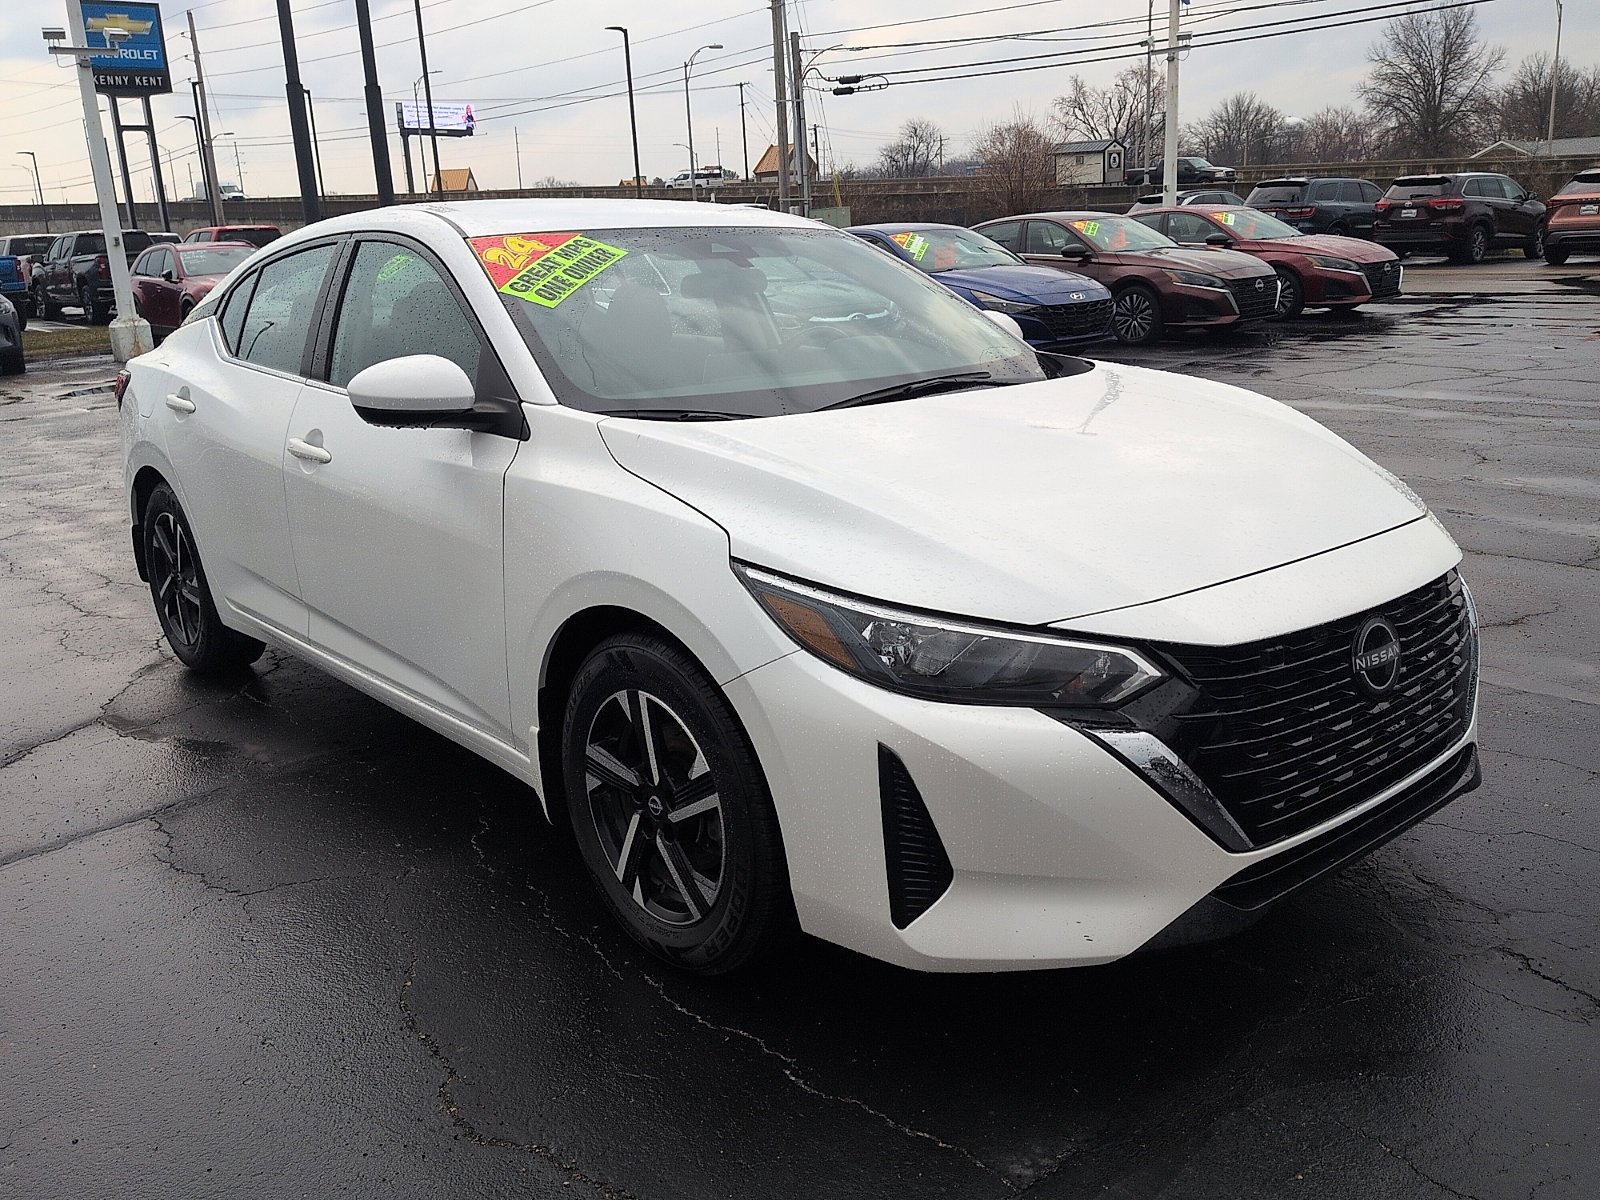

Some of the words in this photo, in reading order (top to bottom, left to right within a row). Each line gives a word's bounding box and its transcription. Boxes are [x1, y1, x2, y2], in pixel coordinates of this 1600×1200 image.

[93, 75, 129, 86] KENNY
[135, 75, 163, 86] KENT
[483, 236, 550, 270] 24
[509, 256, 563, 293] GREAT
[555, 239, 594, 260] MPG
[535, 275, 576, 301] ONE
[562, 247, 616, 280] OWNER
[1356, 643, 1399, 670] NISSAN
